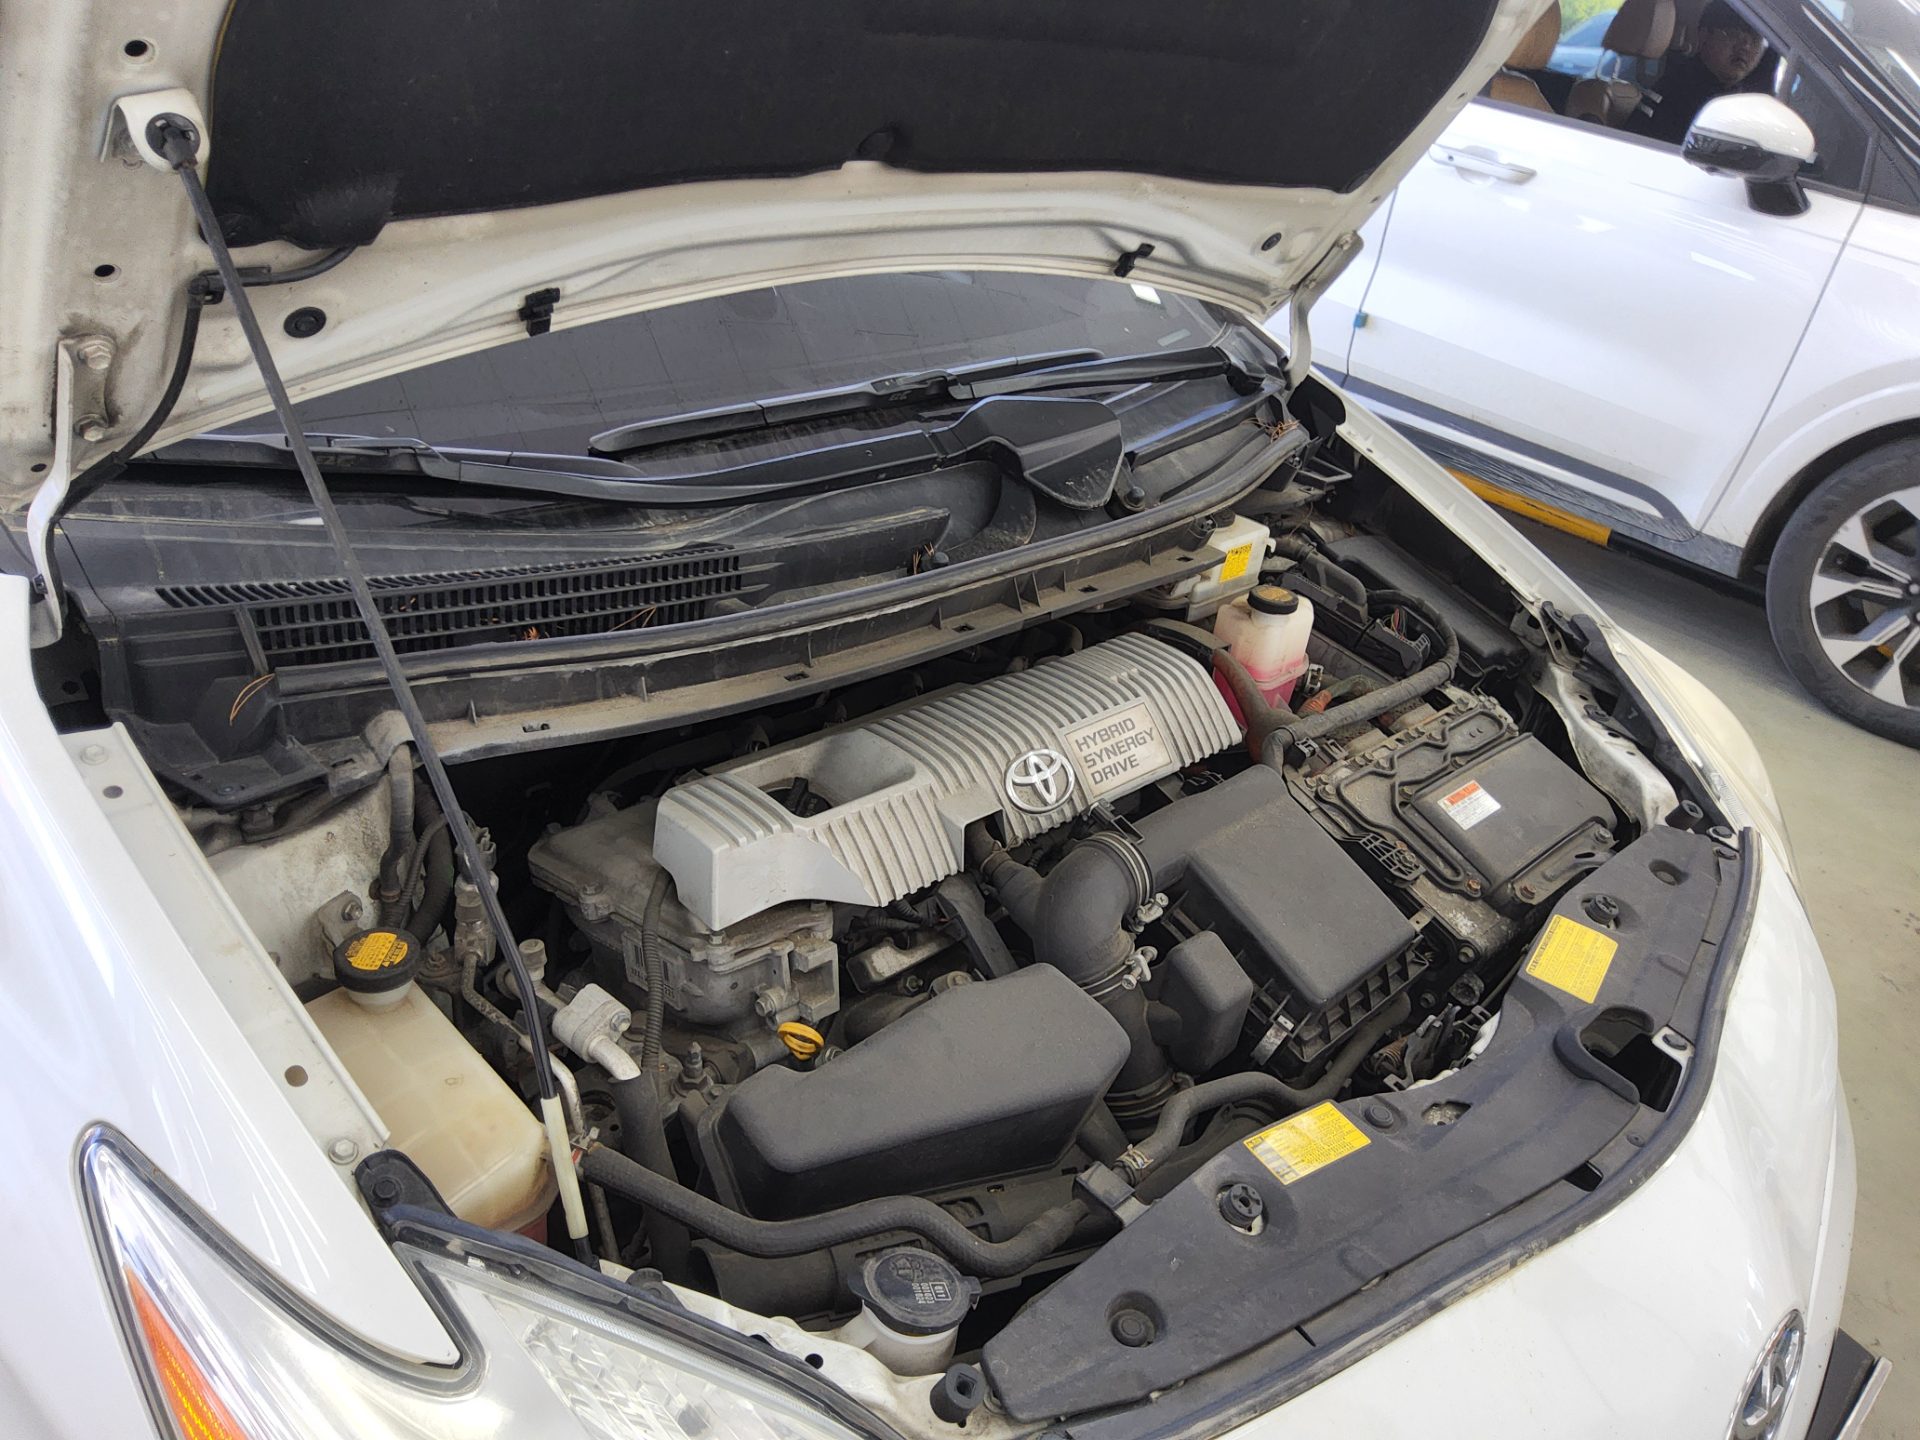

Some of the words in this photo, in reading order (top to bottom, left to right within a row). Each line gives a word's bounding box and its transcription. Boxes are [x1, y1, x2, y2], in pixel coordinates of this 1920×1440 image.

[1075, 718, 1135, 752] HYBRID
[1083, 727, 1154, 768] SYNERGY
[1090, 754, 1140, 785] DRIVE
